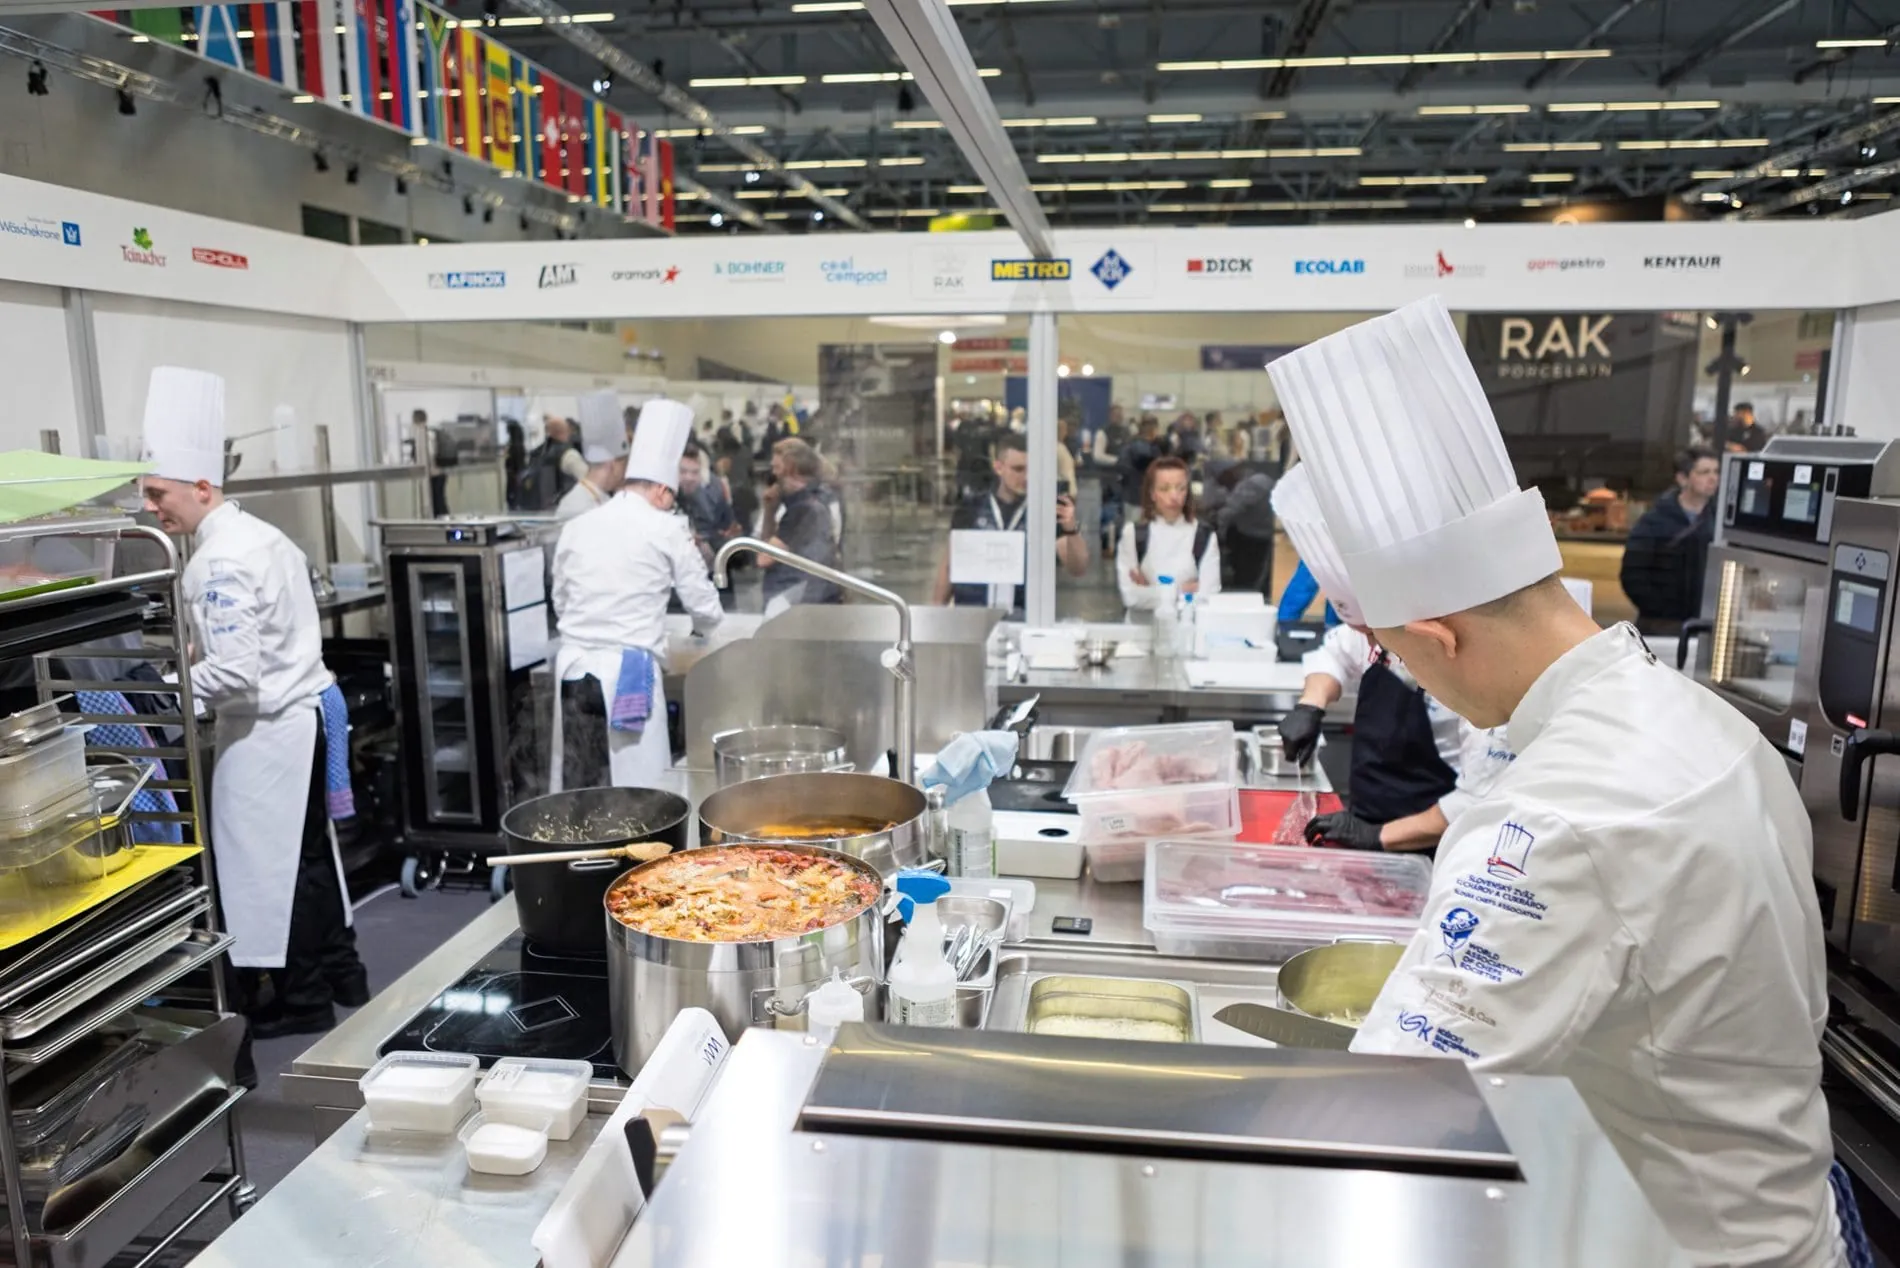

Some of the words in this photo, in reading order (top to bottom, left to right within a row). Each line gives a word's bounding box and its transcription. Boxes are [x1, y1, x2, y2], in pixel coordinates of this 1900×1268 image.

[194, 250, 248, 267] SCHOLL
[820, 256, 853, 271] cool
[1206, 258, 1253, 273] DICK
[1643, 255, 1721, 269] KENTAUR
[611, 269, 661, 281] aramark
[993, 261, 1069, 279] METRO
[1294, 260, 1365, 275] ECOLAB
[826, 269, 887, 284] compact
[933, 276, 965, 288] RAK
[1500, 314, 1613, 360] RAK
[1497, 362, 1613, 378] PORCELAIN
[1468, 942, 1500, 961] WORLD
[1462, 955, 1476, 964] OF
[1475, 961, 1503, 976] CHEFS
[1465, 950, 1524, 976] ASSOCIATION
[1460, 961, 1503, 982] SOCIETIES
